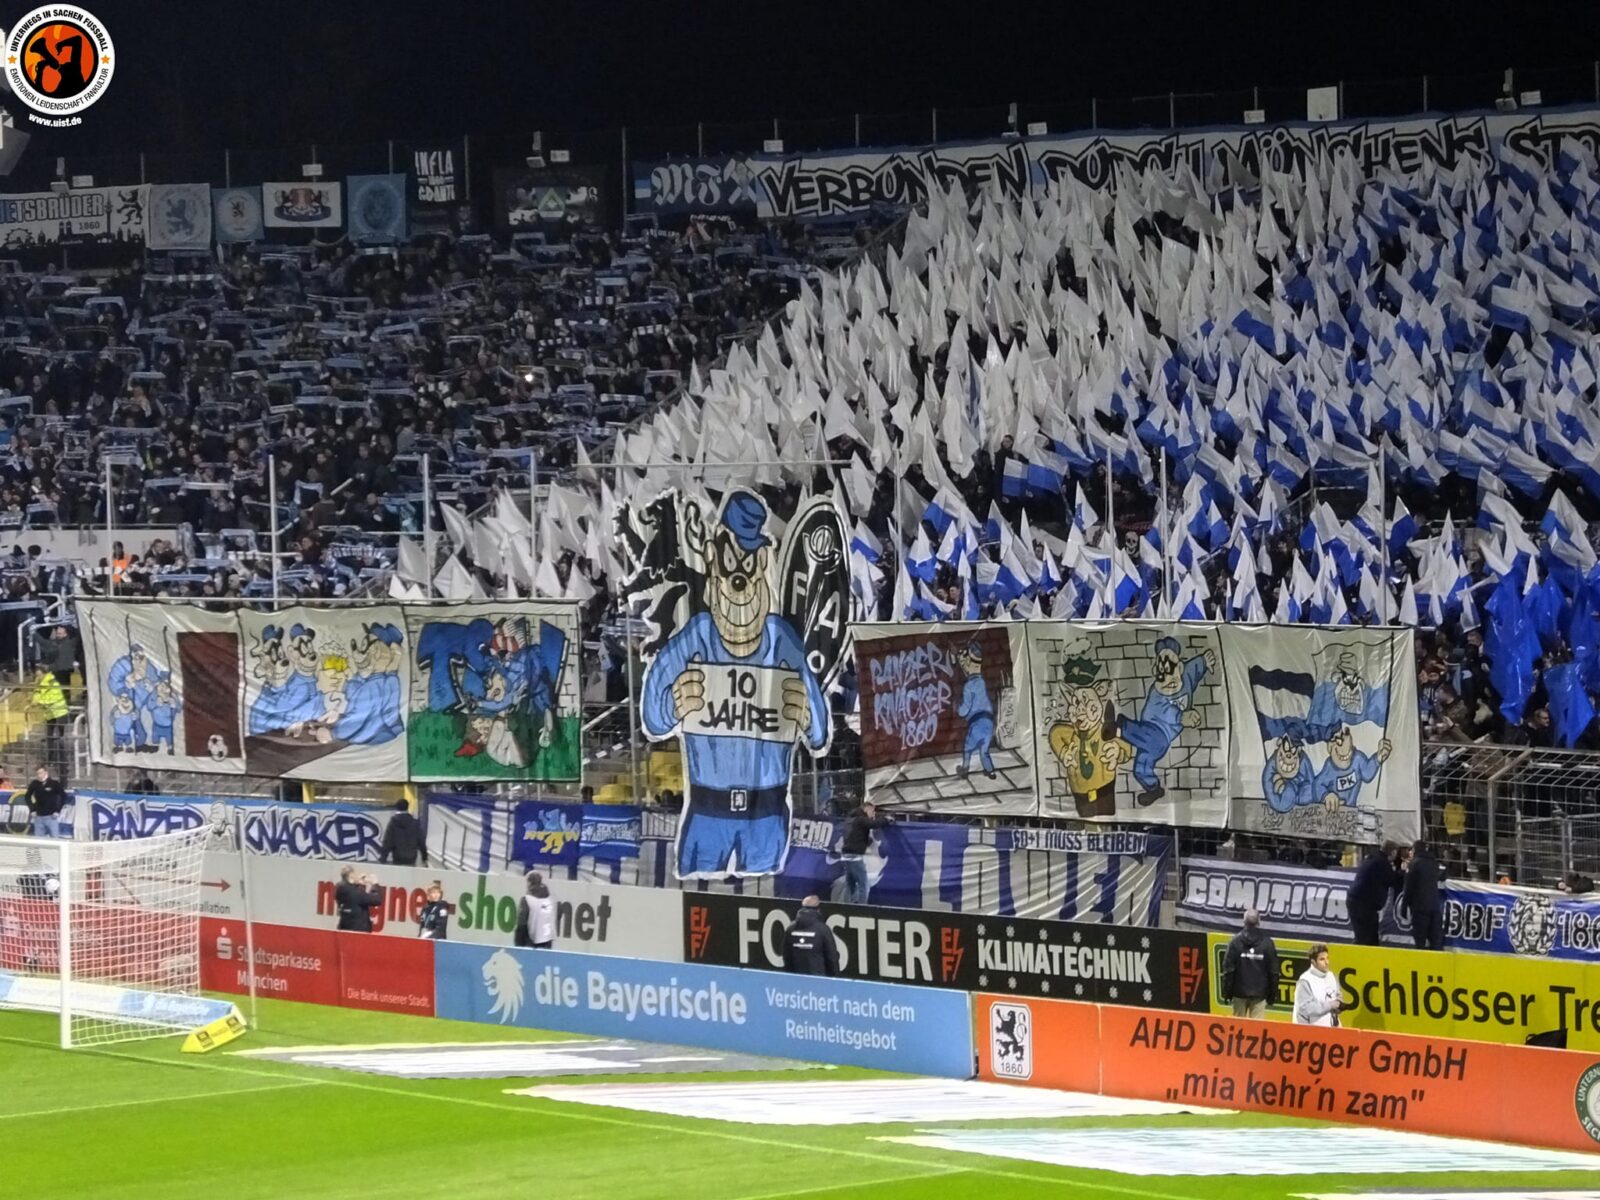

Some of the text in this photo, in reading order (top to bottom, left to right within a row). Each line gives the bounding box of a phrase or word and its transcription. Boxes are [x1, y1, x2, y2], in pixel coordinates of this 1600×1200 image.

[727, 669, 757, 699] 10
[869, 641, 954, 692] PANZER
[699, 702, 780, 733] JAHRE
[874, 680, 952, 735] KNACKER
[899, 714, 938, 751] 1860
[1339, 776, 1354, 788] PK
[238, 808, 383, 860] KNACKER
[1045, 829, 1082, 849] MUSS
[1087, 830, 1147, 853] BLEIBEN!
[738, 907, 932, 982] FOSTER
[978, 939, 1151, 983] KLIMATECHNIK
[347, 986, 359, 1000] Die
[361, 988, 379, 1002] Bank
[380, 992, 407, 1005] unserer
[535, 968, 747, 1026] die Bayerische
[766, 988, 915, 1022] Versichert nach dem
[1339, 967, 1535, 1027] Schlösser
[785, 1019, 898, 1052] Reinheitsgebot
[1131, 1016, 1467, 1081] AHD Sitzberger GmbH
[1000, 1060, 1024, 1074] 1860
